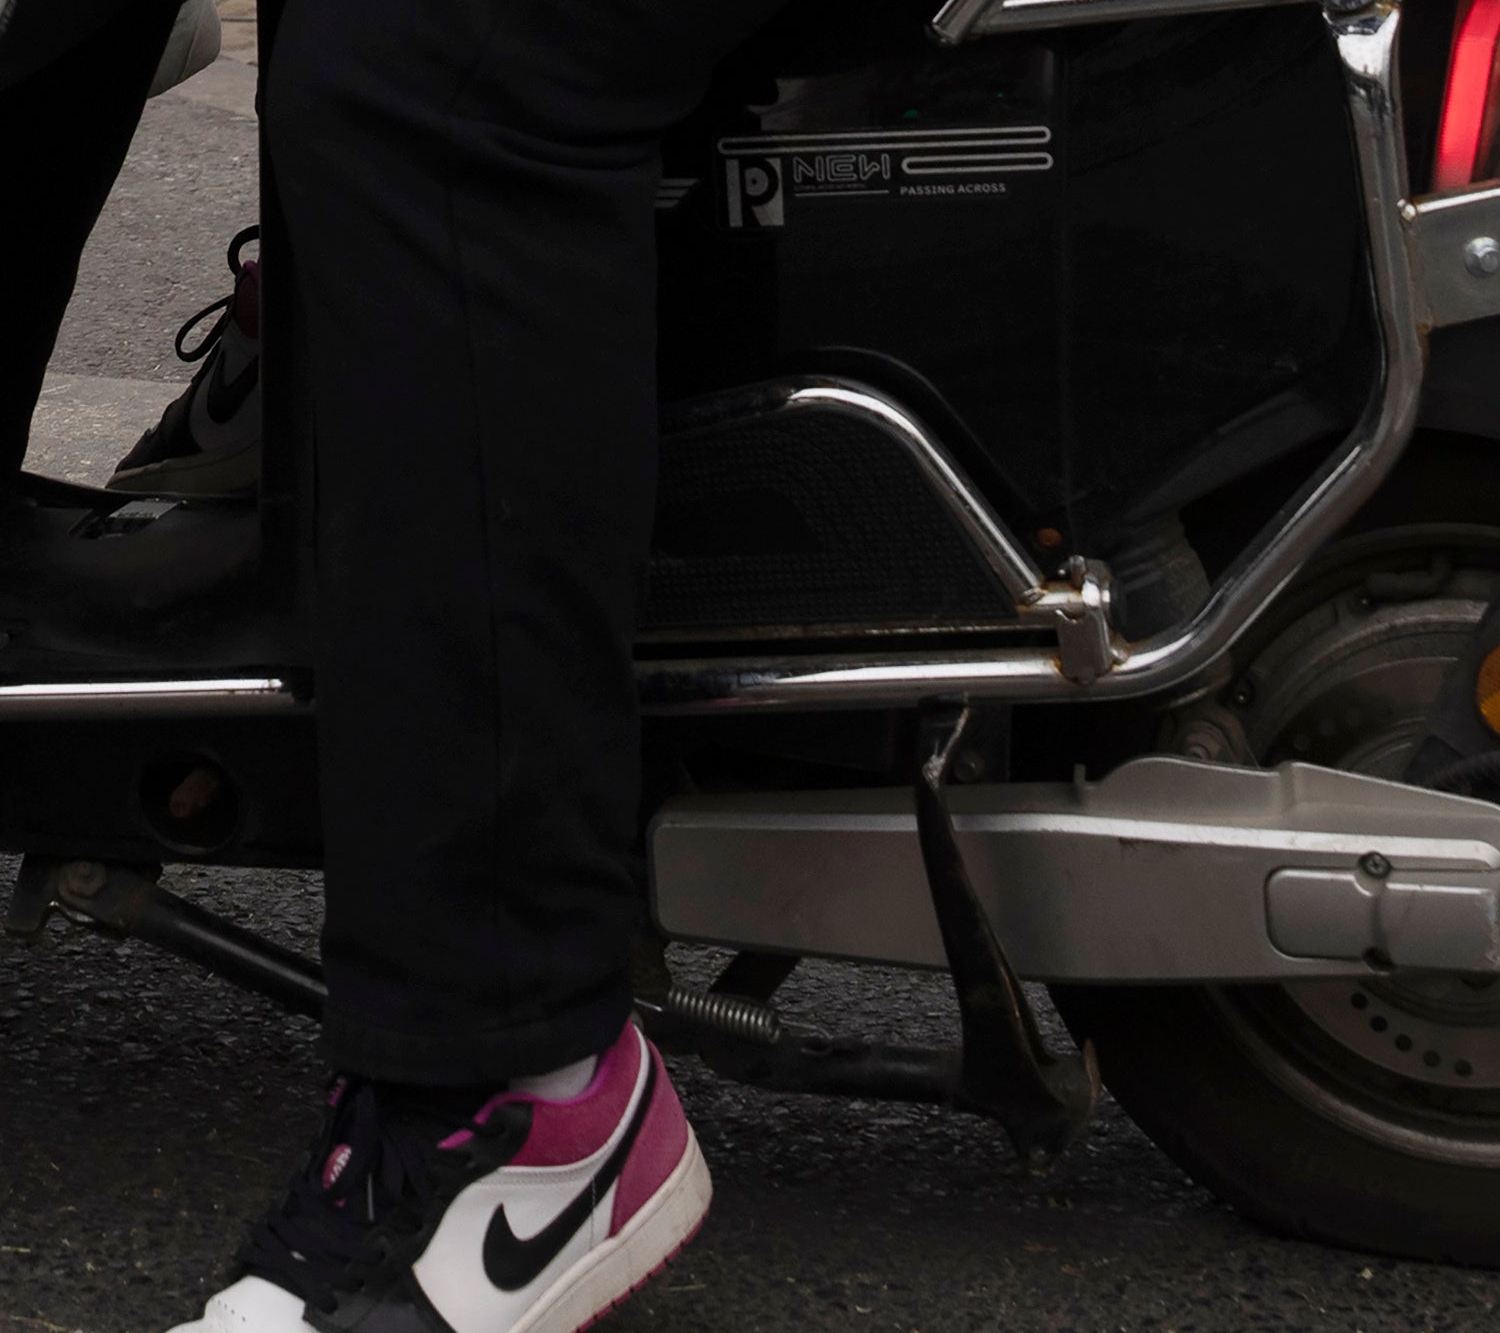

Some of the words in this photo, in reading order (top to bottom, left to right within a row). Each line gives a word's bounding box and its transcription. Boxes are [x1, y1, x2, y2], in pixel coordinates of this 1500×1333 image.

[793, 153, 890, 183] NEW
[900, 185, 955, 197] PASSING
[957, 182, 1006, 195] ACROSS
